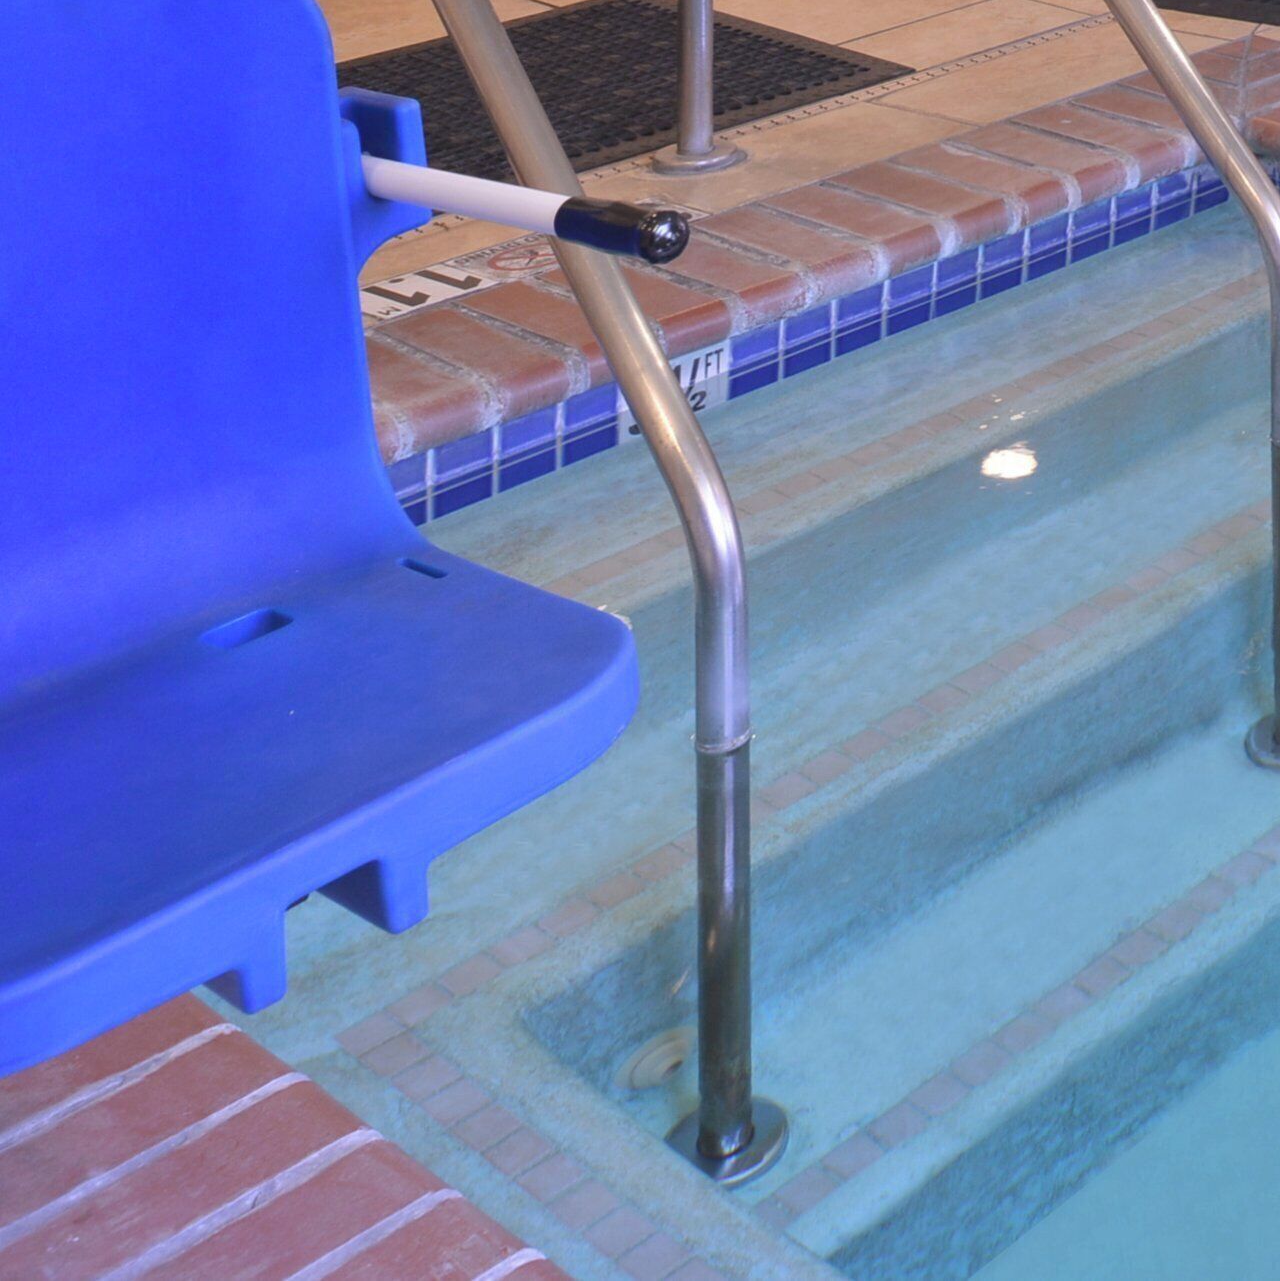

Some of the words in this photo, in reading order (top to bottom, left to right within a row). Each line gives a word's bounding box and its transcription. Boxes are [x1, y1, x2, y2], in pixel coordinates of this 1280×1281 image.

[452, 242, 522, 266] DIVING
[363, 268, 482, 307] 1.1
[704, 348, 724, 379] FT
